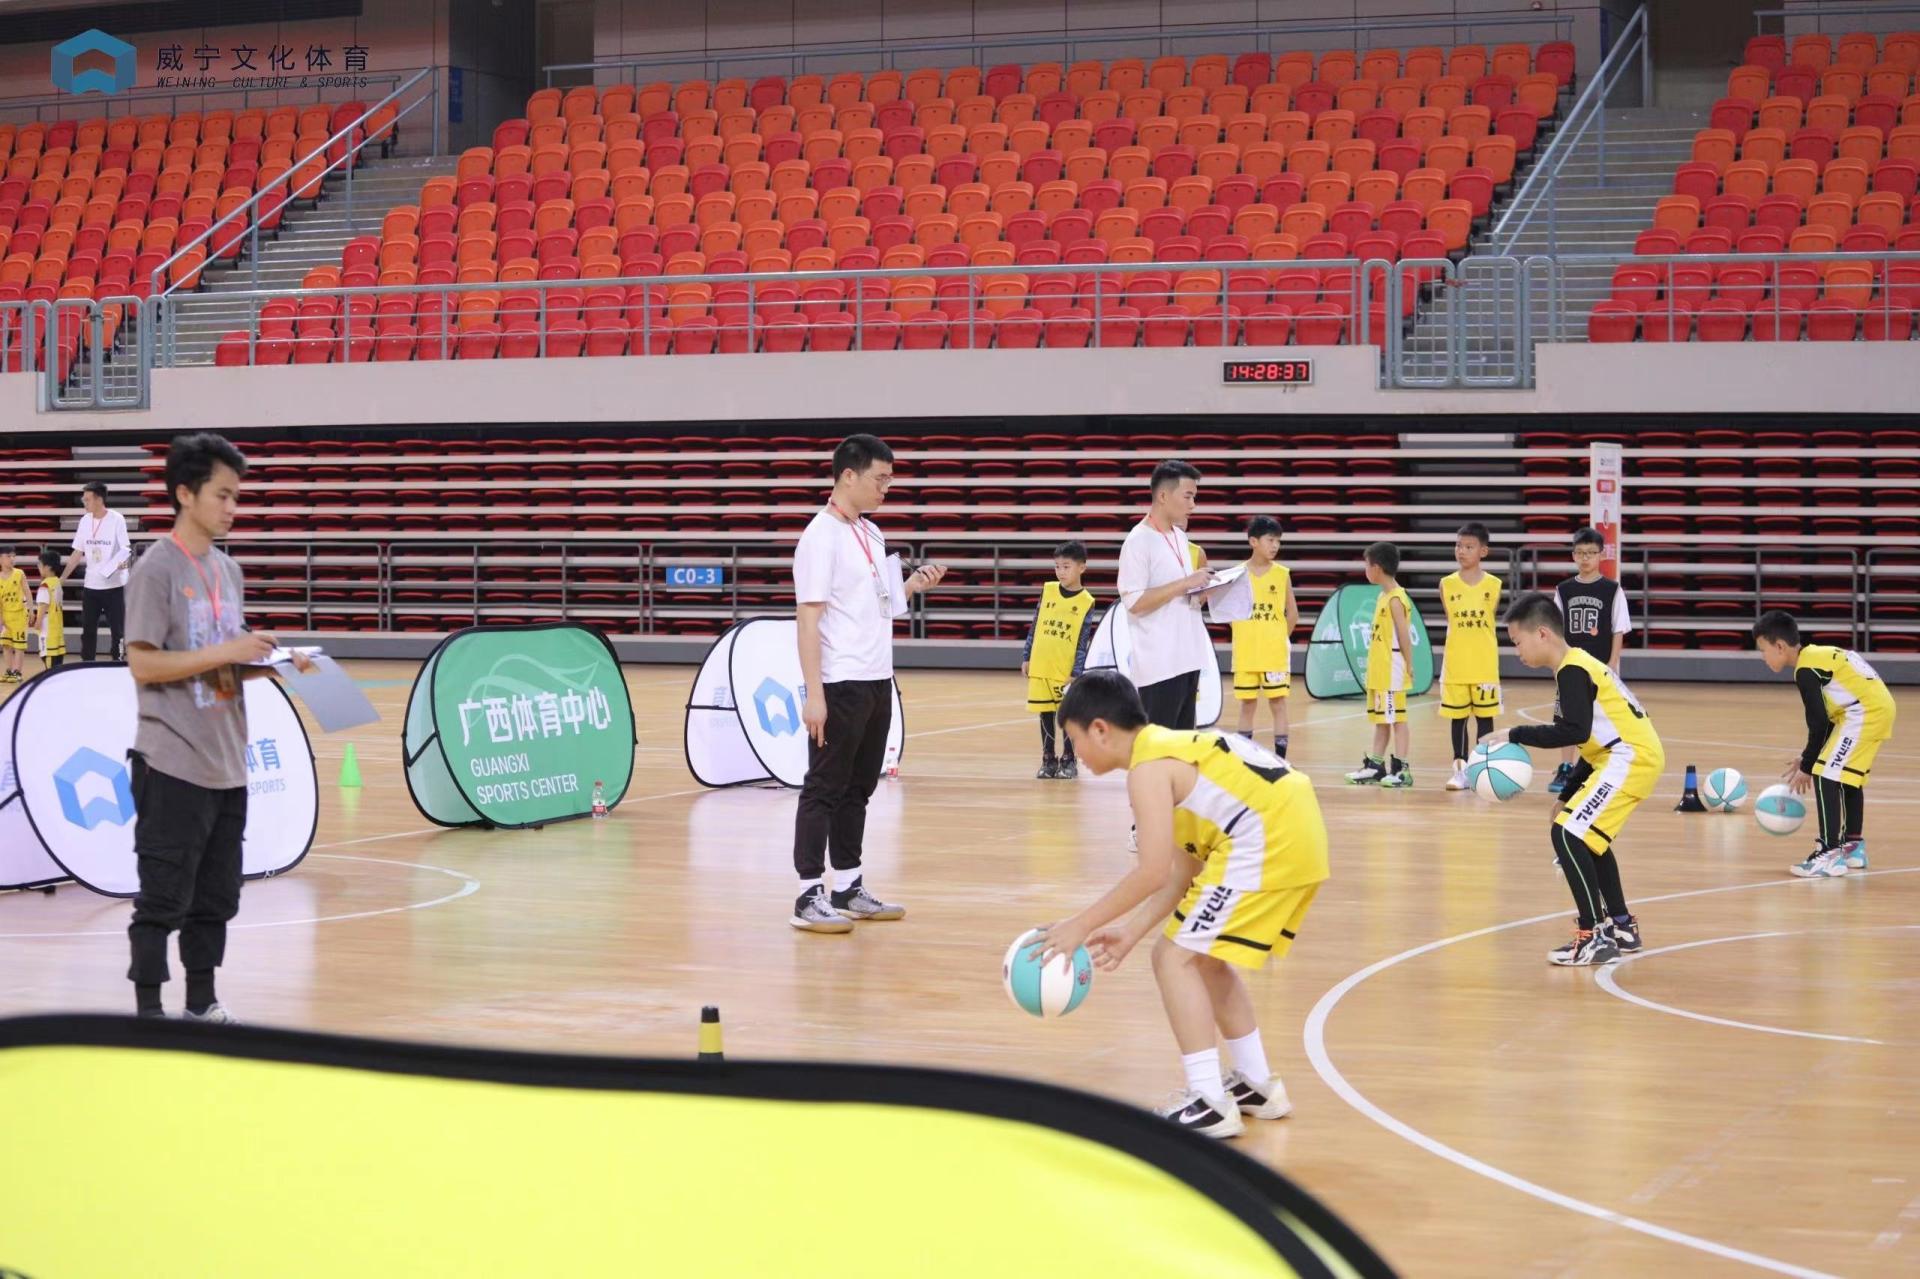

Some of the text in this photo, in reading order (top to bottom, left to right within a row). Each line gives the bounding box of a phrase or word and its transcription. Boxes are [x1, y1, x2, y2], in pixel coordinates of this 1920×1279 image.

[1232, 364, 1307, 379] 14:28:37
[458, 686, 612, 746] 广西体育中心
[470, 753, 530, 777] GUANGXI
[477, 773, 579, 805] SPORTS CENTER
